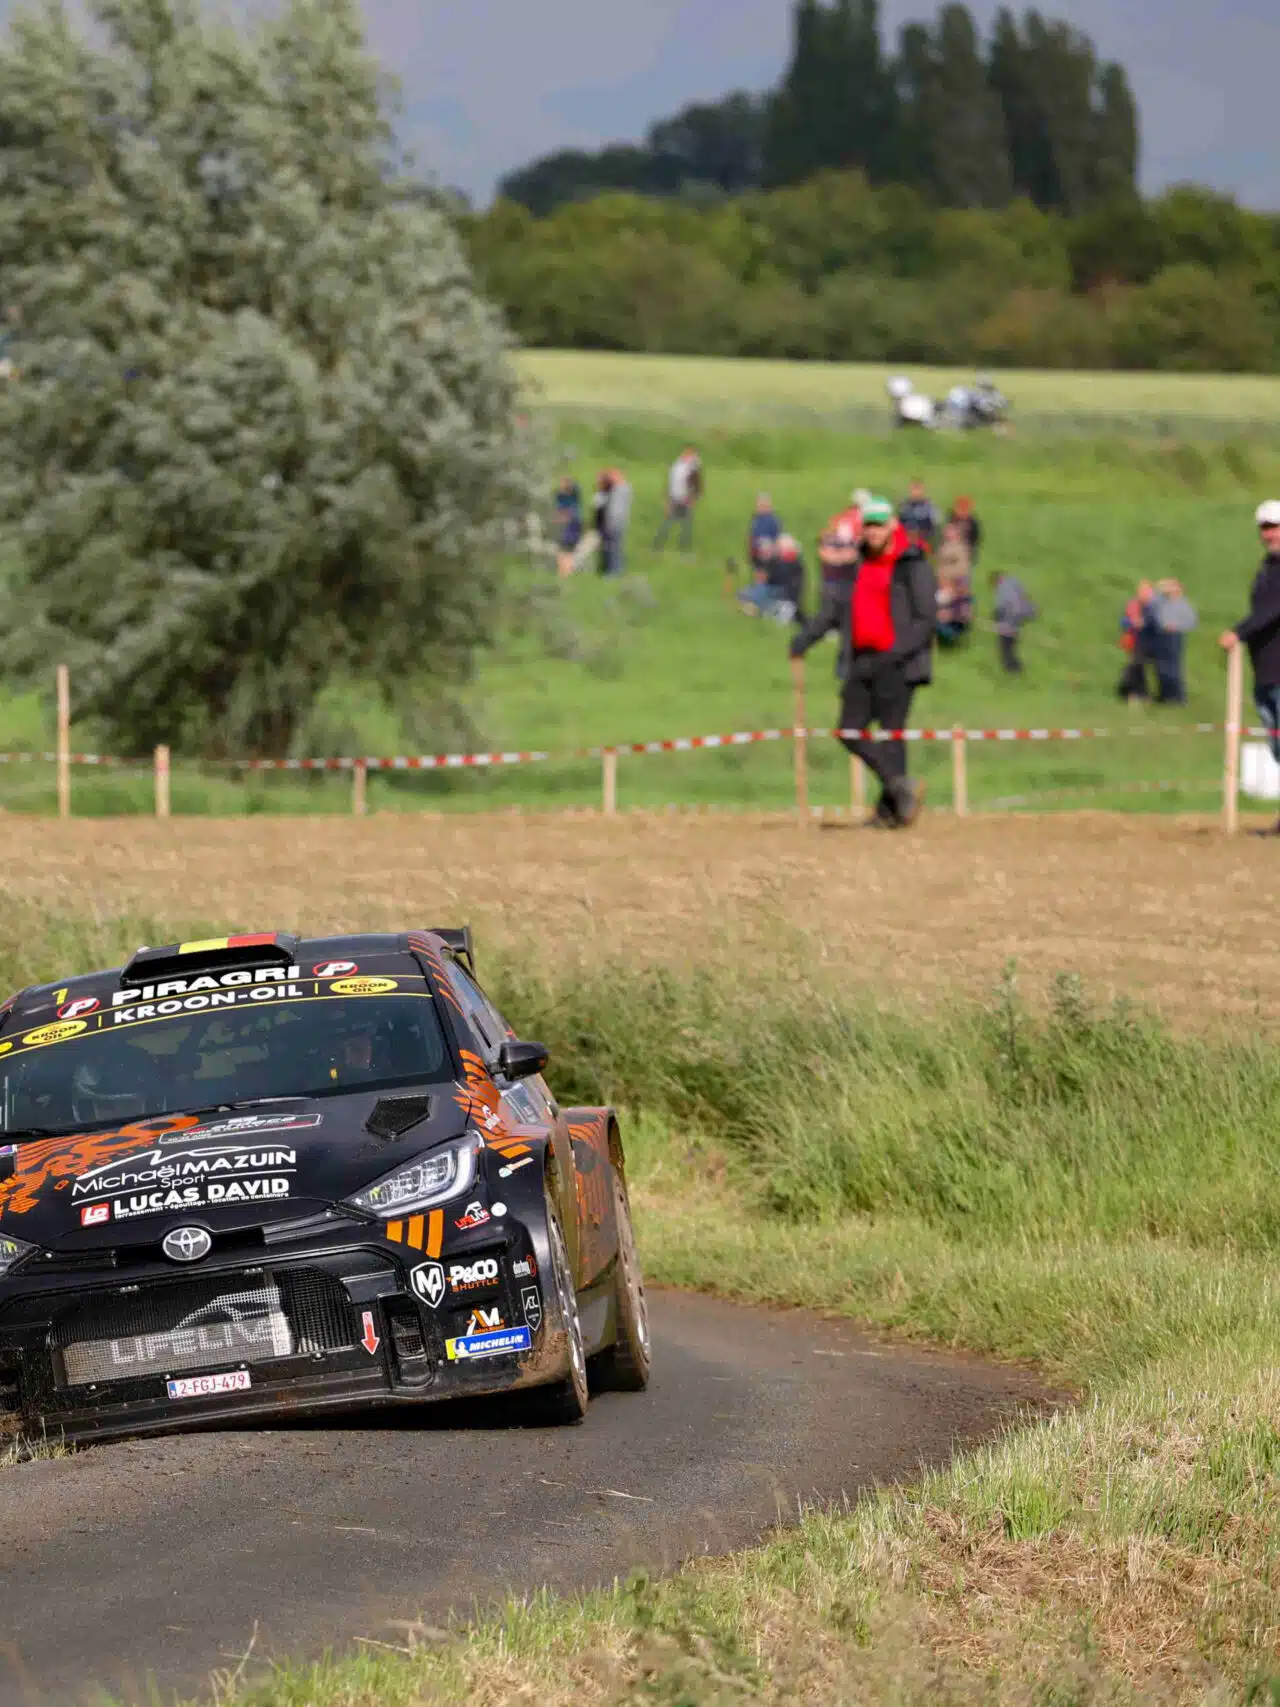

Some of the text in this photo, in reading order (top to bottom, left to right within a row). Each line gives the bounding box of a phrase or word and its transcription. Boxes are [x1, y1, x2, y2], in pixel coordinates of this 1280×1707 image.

[112, 965, 300, 1006] PIRAGRI
[340, 981, 388, 990] KROON
[52, 988, 68, 1005] 1
[114, 985, 303, 1024] KROON-OIL
[32, 1024, 77, 1040] KROON
[182, 1150, 297, 1175] MAZUIN
[160, 1173, 206, 1190] Sport
[114, 1178, 290, 1215] LUCAS DAVID
[211, 1195, 240, 1203] location
[250, 1191, 289, 1200] containers
[450, 1258, 498, 1286] P&CO
[452, 1277, 500, 1293] SHUTTLE
[469, 1334, 524, 1352] MICHELIN
[179, 1374, 246, 1395] 2-FGJ-479
